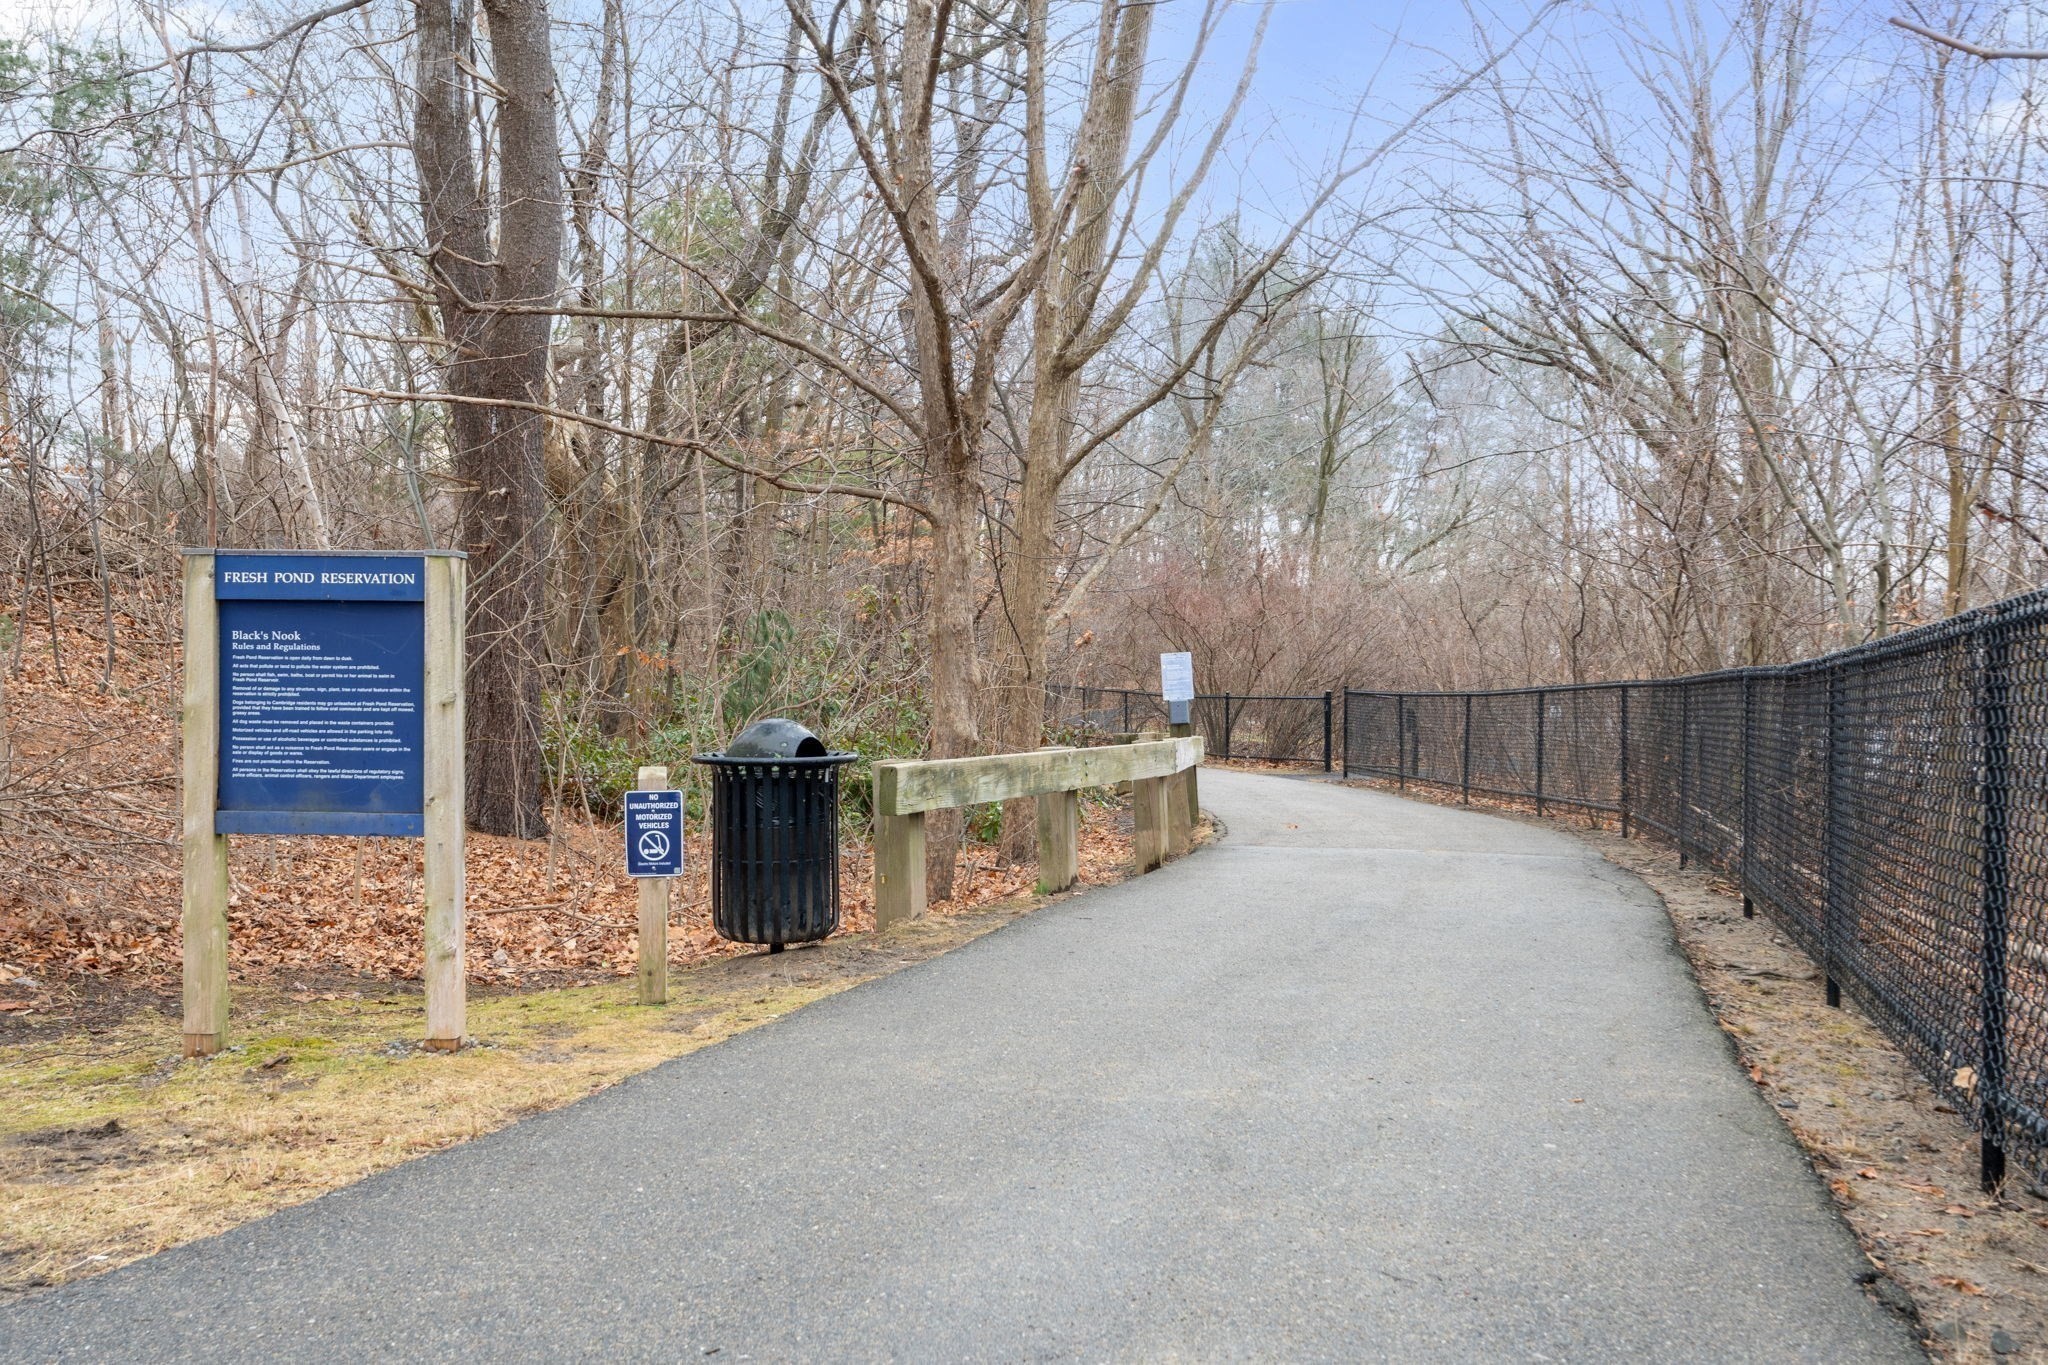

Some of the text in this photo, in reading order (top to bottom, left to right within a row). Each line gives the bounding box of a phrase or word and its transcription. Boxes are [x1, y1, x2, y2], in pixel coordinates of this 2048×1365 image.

[224, 572, 415, 585] FRESH POND RESERVATION
[232, 630, 301, 641] Black's Nook
[232, 642, 321, 652] Rules and Regulations
[629, 802, 679, 810] UNAUTHORIZED
[635, 813, 673, 821] MOTORIZED
[638, 822, 670, 830] VEHICLES
